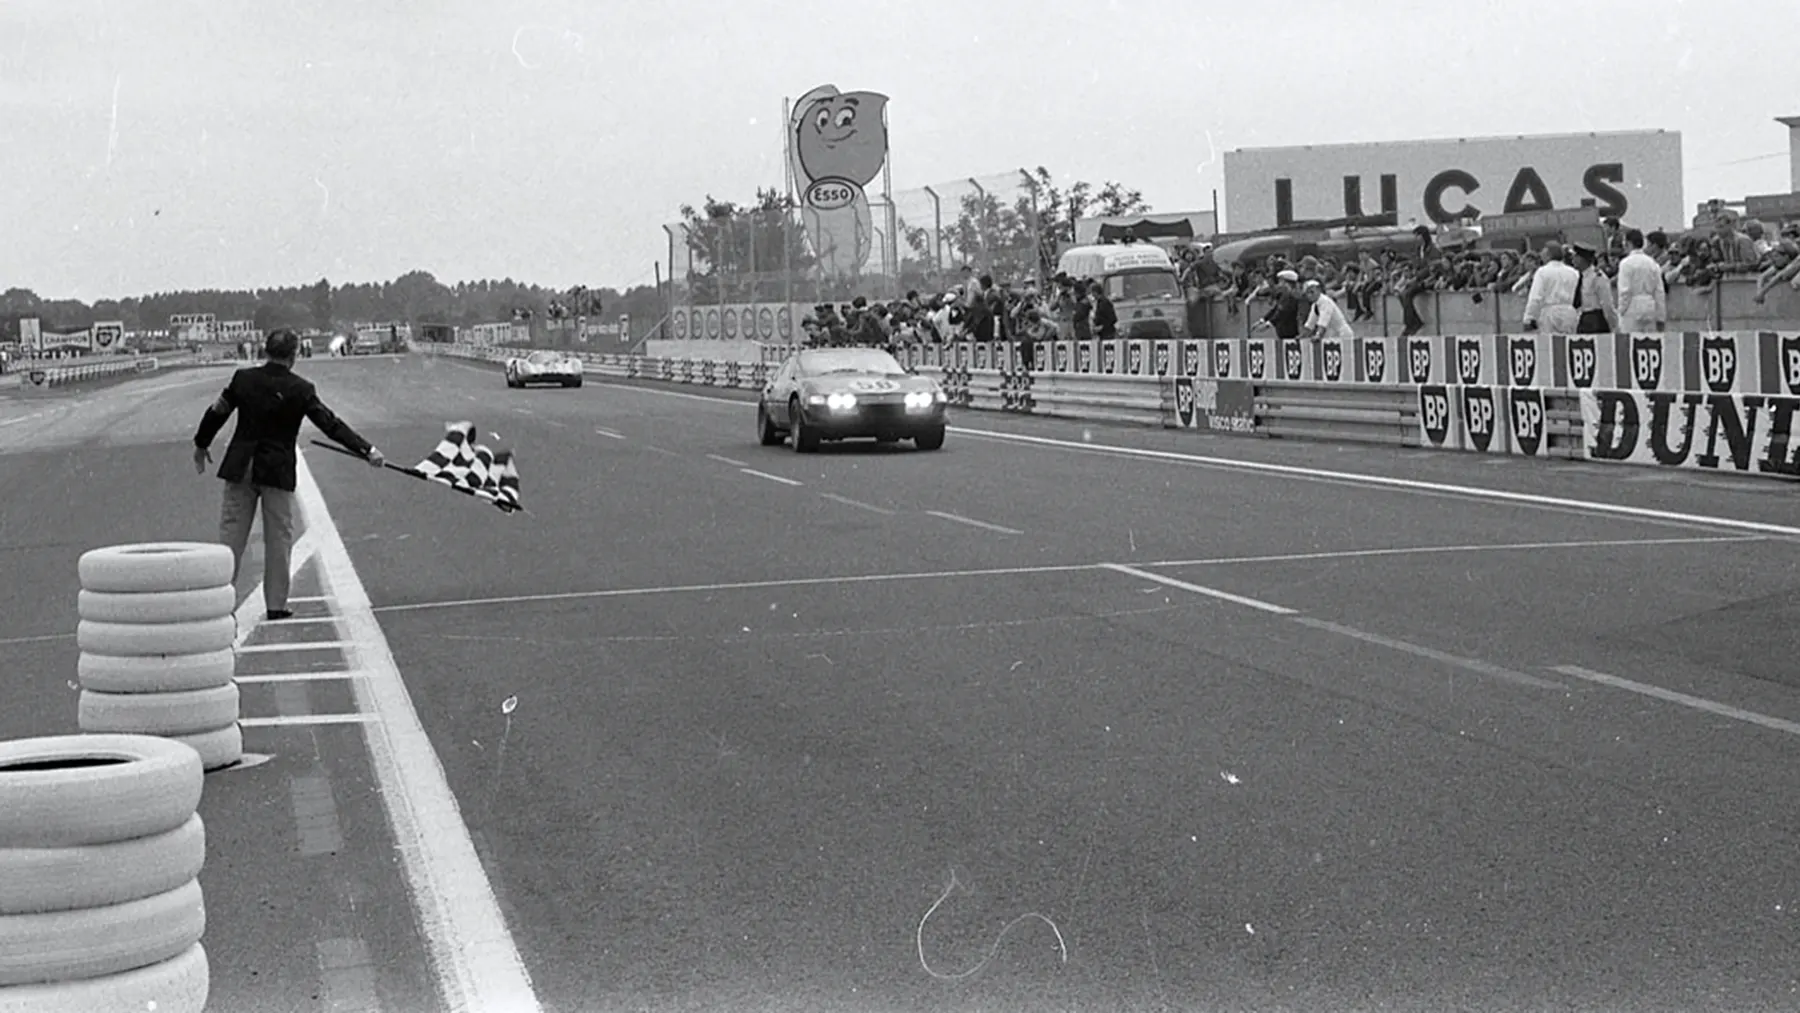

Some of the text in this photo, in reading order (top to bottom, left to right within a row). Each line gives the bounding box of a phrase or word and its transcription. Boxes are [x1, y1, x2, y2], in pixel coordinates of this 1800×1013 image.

[1275, 163, 1627, 226] LUCAS
[206, 322, 252, 332] Shell
[1218, 350, 1228, 373] BP
[1251, 350, 1263, 374] BP
[1287, 350, 1300, 375] BP
[1326, 350, 1339, 376] BP
[1368, 349, 1382, 377] BP
[1412, 349, 1429, 377] BP
[1461, 348, 1479, 379] BP
[1513, 348, 1533, 379] BP
[1571, 348, 1593, 380] BP
[1637, 348, 1660, 382] BP
[1708, 348, 1733, 383] BP
[1788, 349, 1800, 385] B
[1178, 384, 1193, 413] BP
[1423, 394, 1447, 430] BP
[1468, 397, 1492, 434] BP
[1515, 400, 1541, 438] BP
